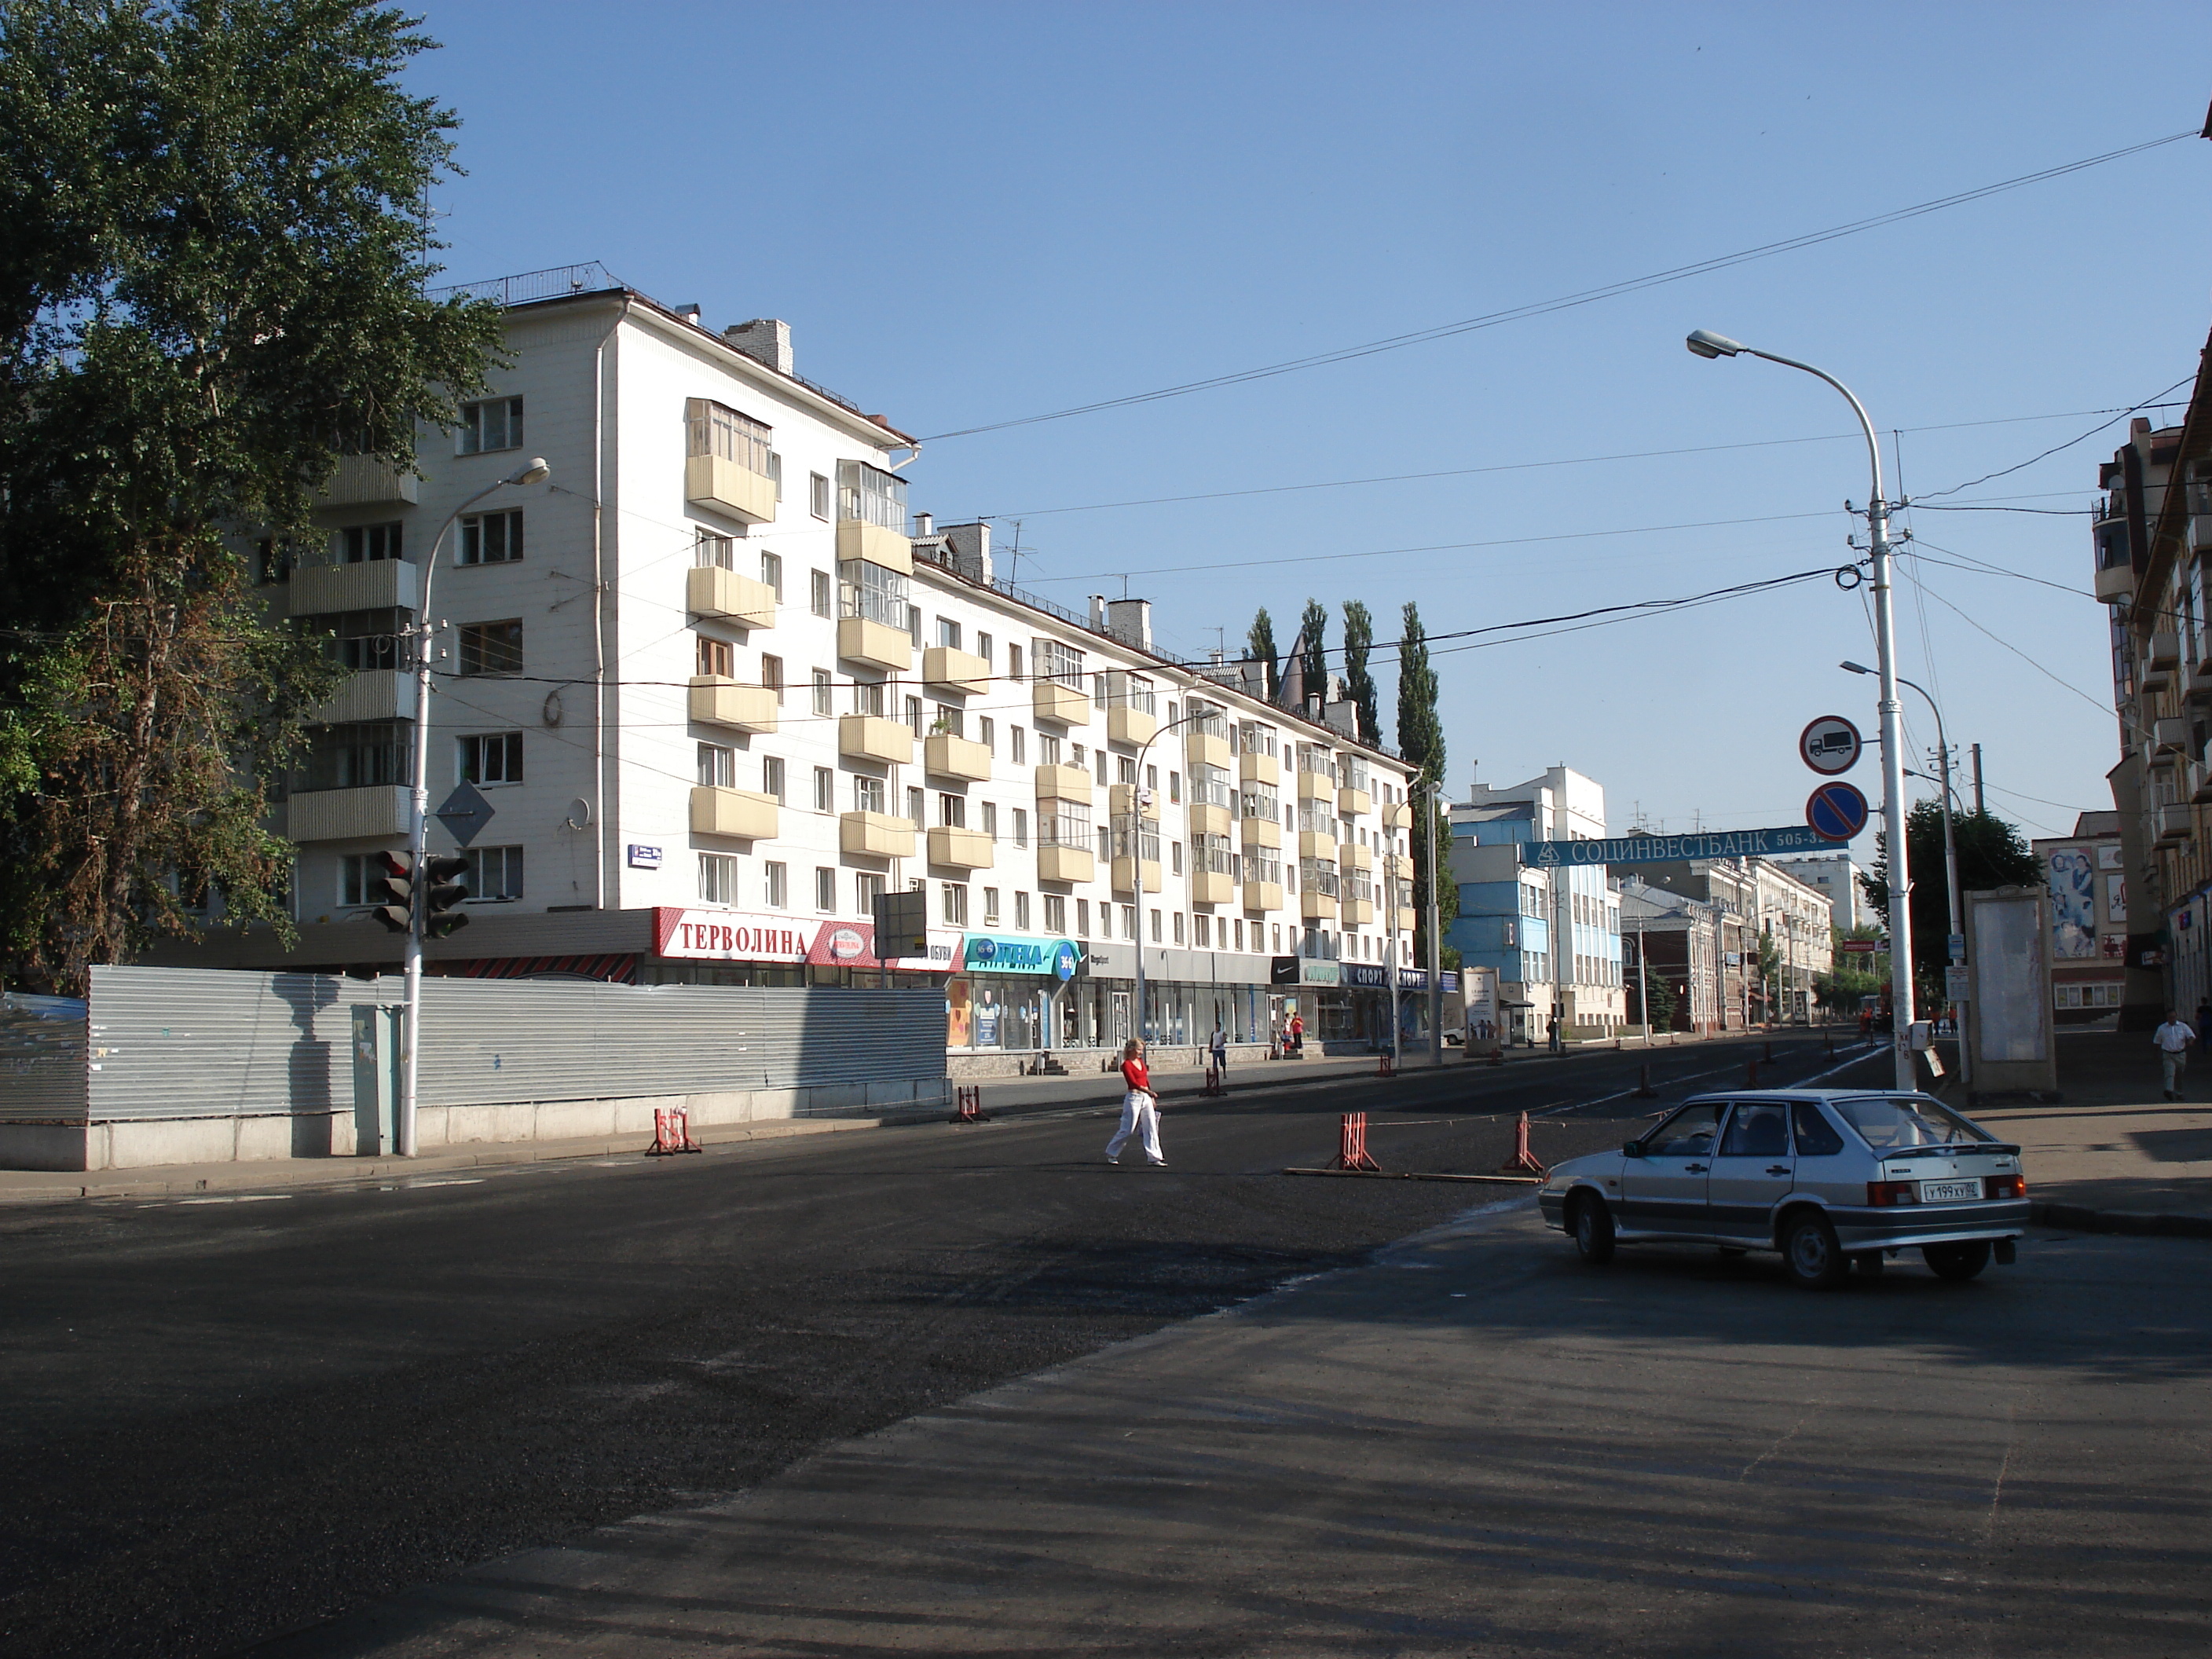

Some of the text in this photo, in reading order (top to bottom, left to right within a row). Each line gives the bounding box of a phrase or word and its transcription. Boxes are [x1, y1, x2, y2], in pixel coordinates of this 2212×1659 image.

[1572, 831, 1769, 862] СОЦИНВЕСТБАНК
[679, 923, 807, 955] ТЕРВОЛИНА
[930, 945, 951, 961] ОБУВИ
[991, 943, 1042, 965] ПТЕКА
[1357, 968, 1382, 985] СПОРТ
